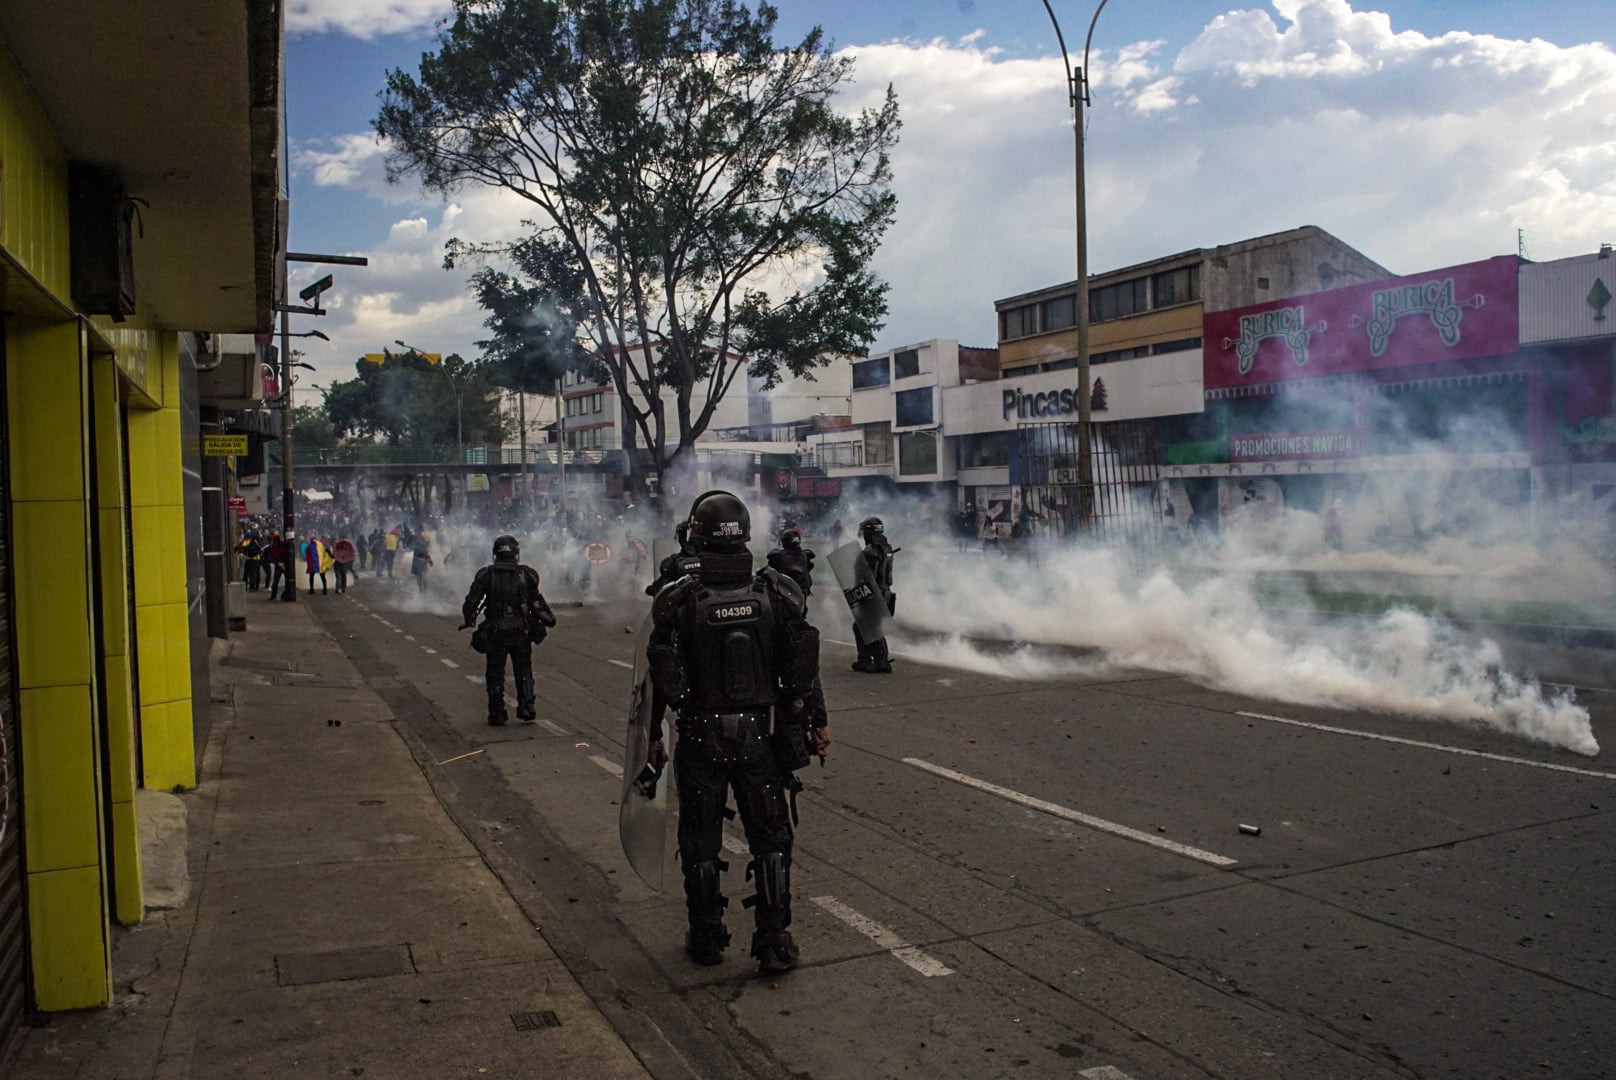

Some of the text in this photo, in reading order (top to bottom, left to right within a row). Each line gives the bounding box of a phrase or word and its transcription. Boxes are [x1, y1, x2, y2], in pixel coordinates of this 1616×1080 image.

[1369, 279, 1460, 333] BURICA
[1238, 304, 1308, 355] BURICA
[1235, 437, 1309, 457] PROMOCIONES
[715, 605, 752, 619] 104309
